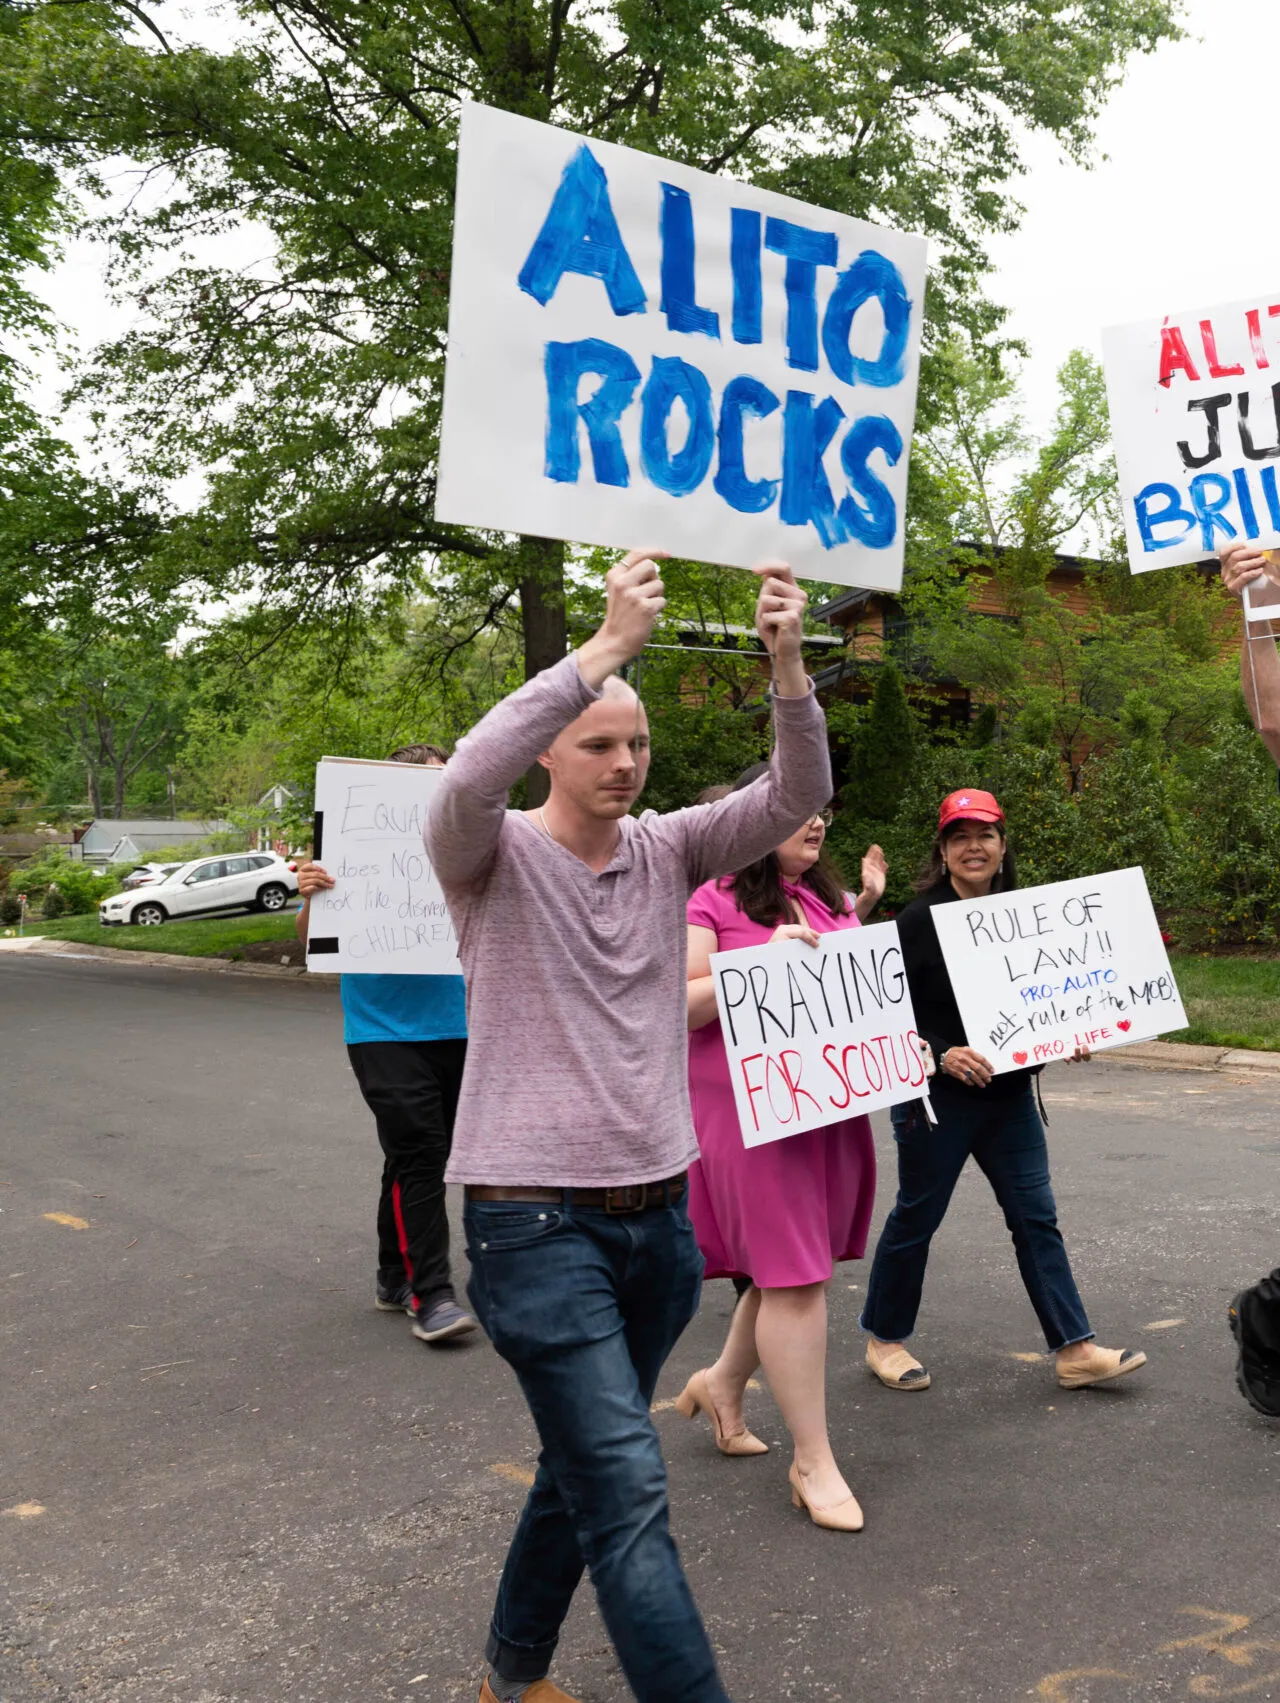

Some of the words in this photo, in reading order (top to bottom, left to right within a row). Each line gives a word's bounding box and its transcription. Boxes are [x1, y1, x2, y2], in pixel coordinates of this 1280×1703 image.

[517, 142, 912, 388] ALITO
[543, 337, 904, 551] ROCKS
[336, 857, 381, 879] does
[364, 882, 392, 911] like
[966, 903, 1055, 948] RULE
[1062, 892, 1104, 927] OF
[720, 947, 905, 1047] PRAYING
[1019, 968, 1119, 1007] PRO-ALITO
[988, 1009, 1026, 1047] not
[1026, 1000, 1071, 1033] rule
[1076, 995, 1093, 1023] of
[1098, 989, 1128, 1012] the
[1032, 1026, 1113, 1063] PRO-LIFE
[740, 1049, 823, 1132] FOR
[822, 1030, 925, 1110] SCOTUS
